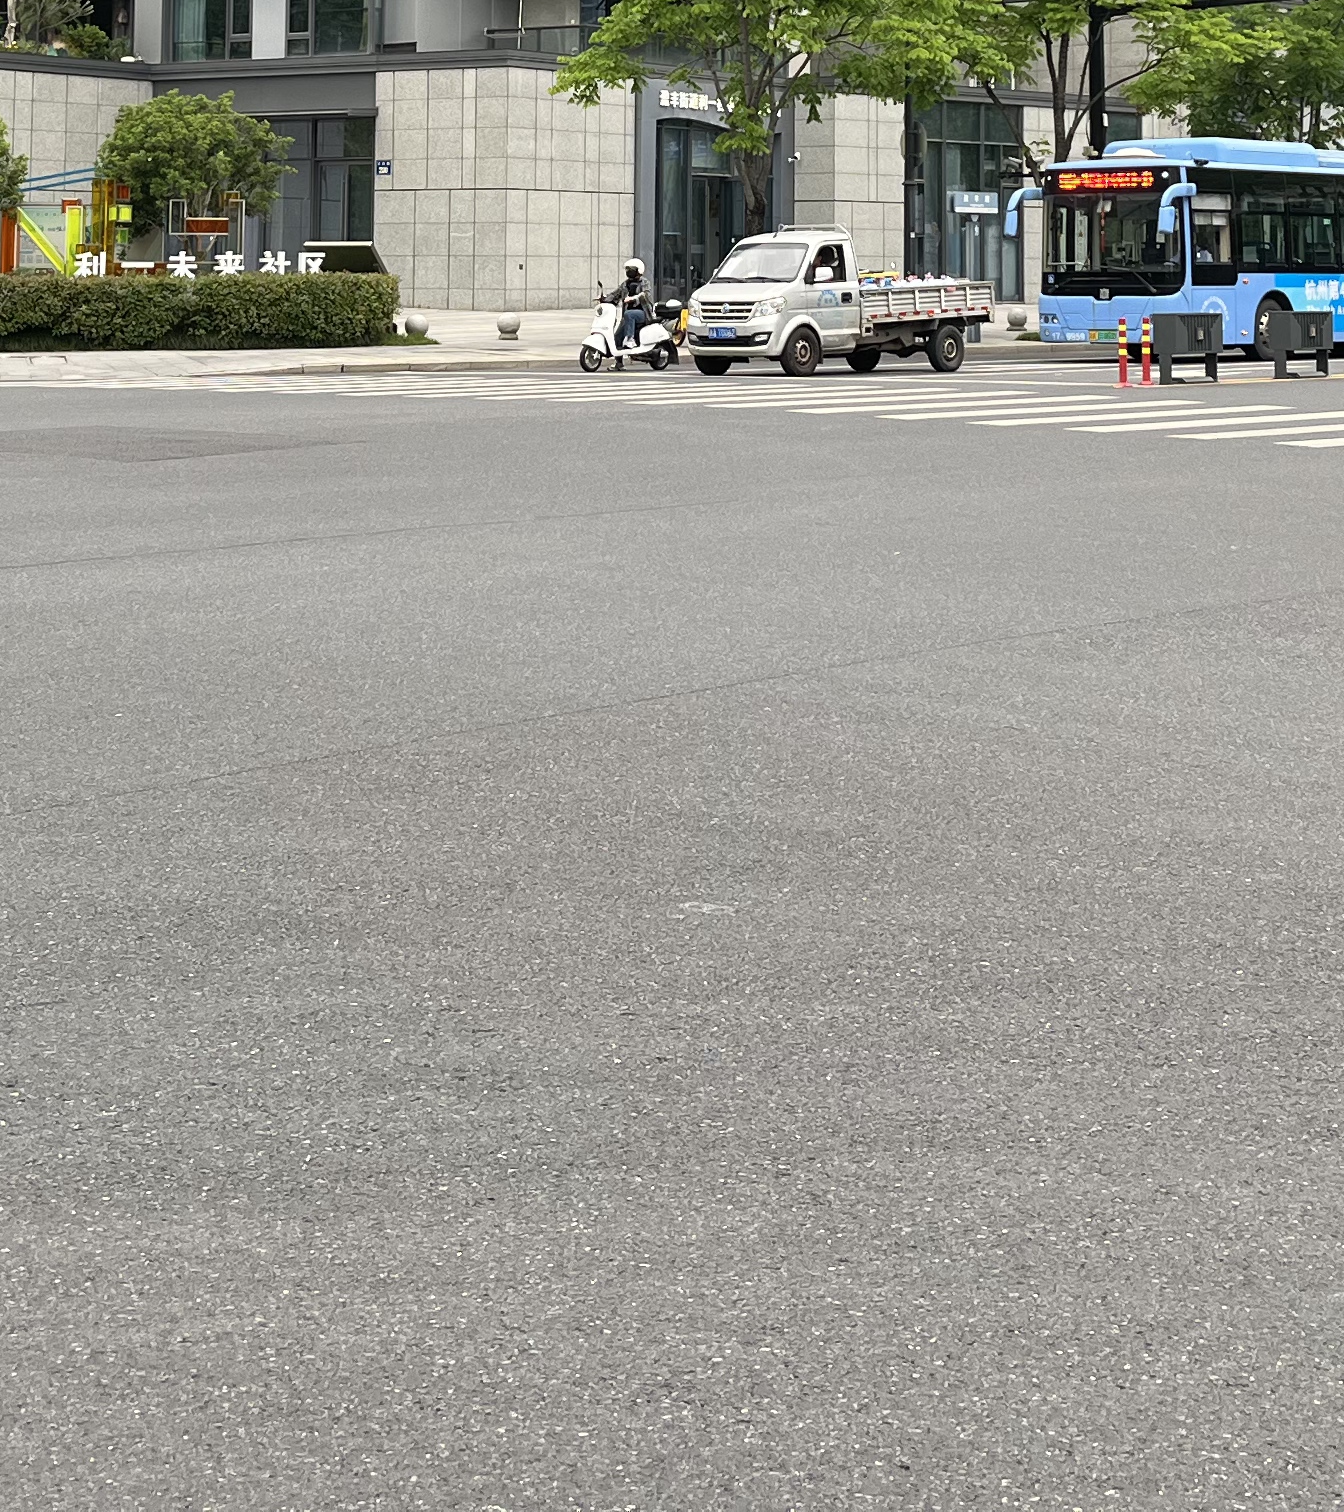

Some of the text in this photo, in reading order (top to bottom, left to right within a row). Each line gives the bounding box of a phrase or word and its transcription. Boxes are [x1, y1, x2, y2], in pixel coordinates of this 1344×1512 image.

[74, 250, 327, 279] 利一未来社区
